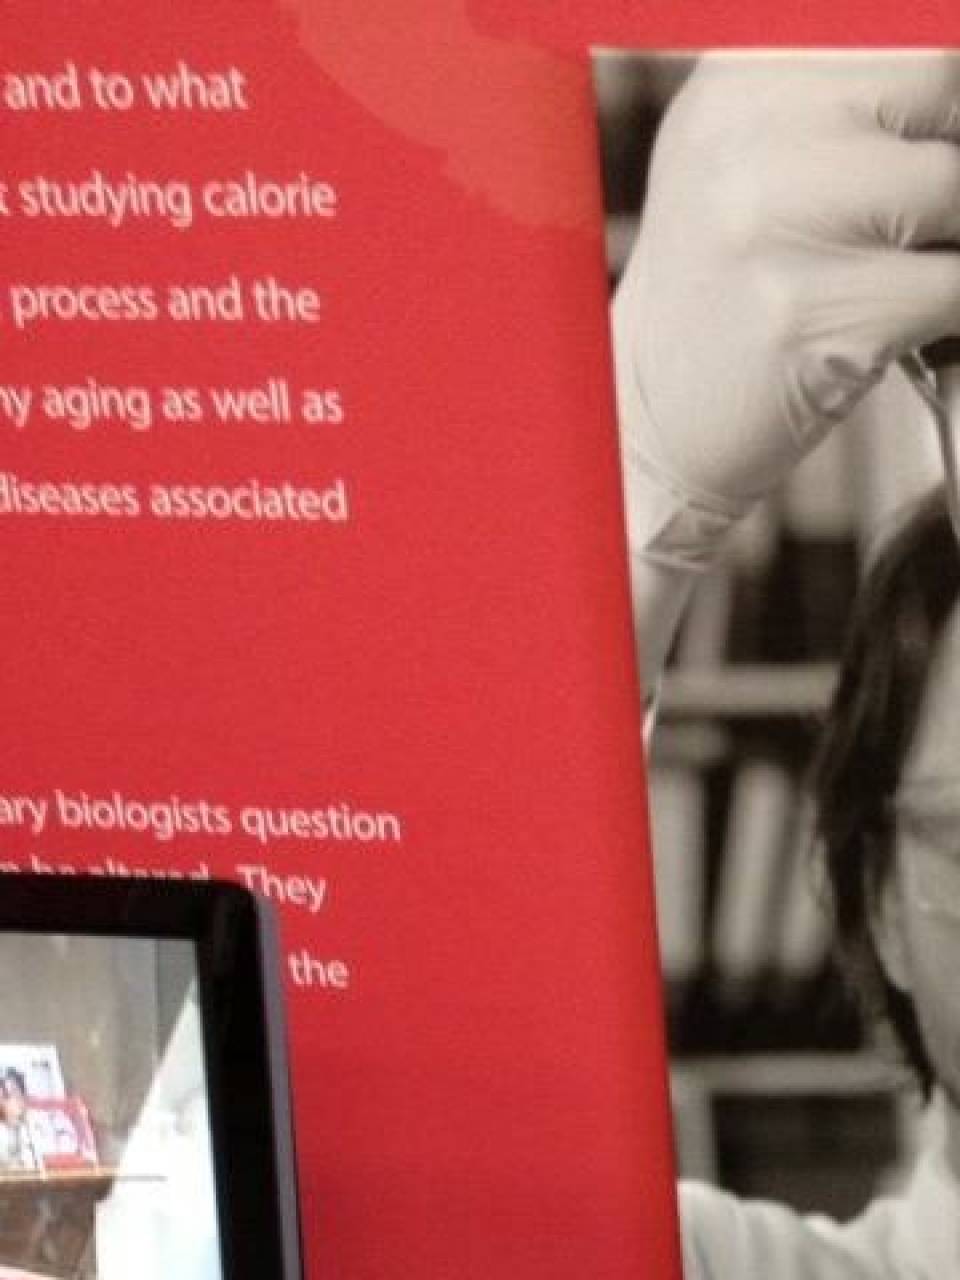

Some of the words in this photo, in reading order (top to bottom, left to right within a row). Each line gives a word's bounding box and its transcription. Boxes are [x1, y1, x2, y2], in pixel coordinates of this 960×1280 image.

[4, 60, 80, 110] and
[89, 65, 134, 110] to
[143, 59, 249, 110] what
[20, 168, 193, 229] studying
[203, 169, 338, 218] calorie
[10, 283, 158, 330] process
[168, 273, 244, 321] and
[253, 274, 321, 323] the
[42, 376, 153, 431] aging
[162, 387, 202, 424] as
[210, 376, 291, 424] well
[301, 388, 345, 425] as
[150, 477, 349, 522] associated
[54, 788, 232, 841] biologists
[240, 802, 401, 844] question
[235, 863, 328, 914] They
[287, 949, 350, 990] the
